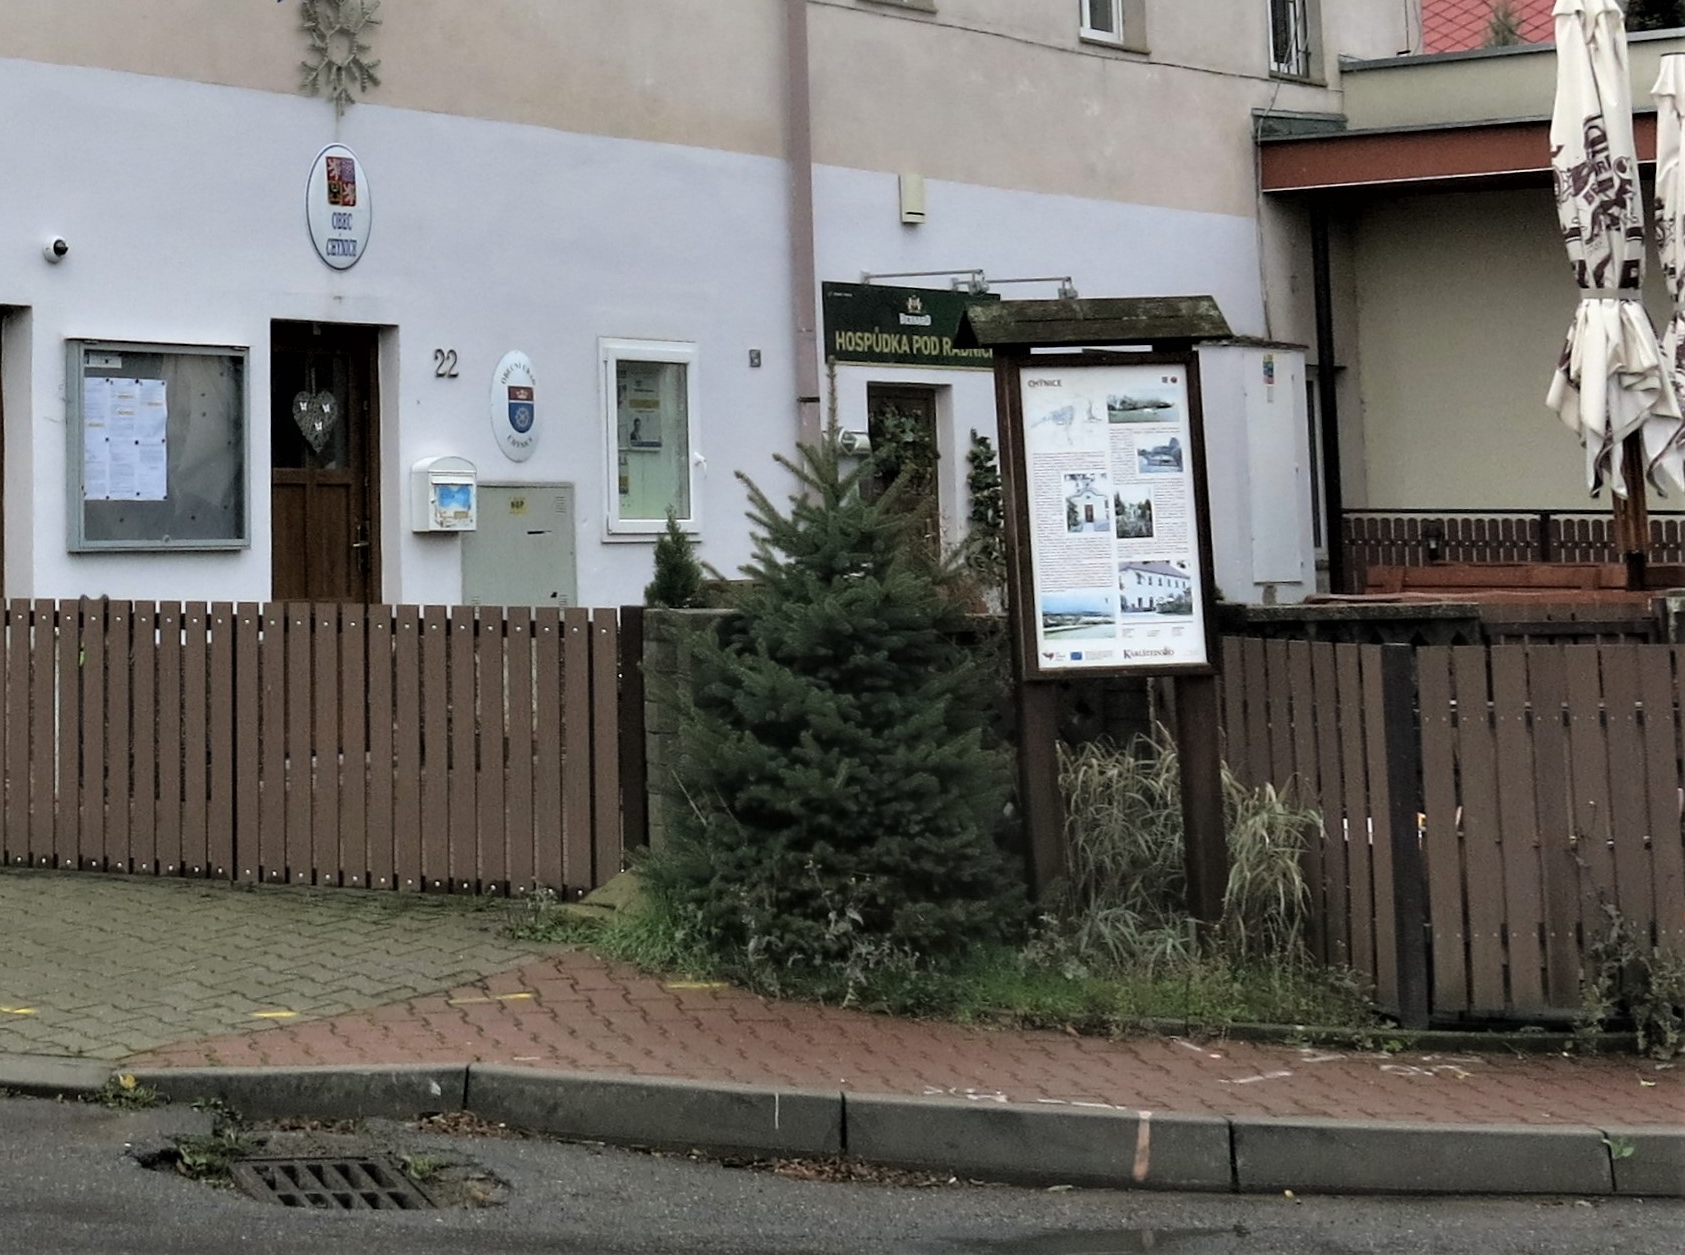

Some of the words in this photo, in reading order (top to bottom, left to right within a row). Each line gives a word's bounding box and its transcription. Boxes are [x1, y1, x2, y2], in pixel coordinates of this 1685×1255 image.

[331, 211, 353, 231] OBEC
[835, 326, 910, 354] HOSPŮDKA
[913, 334, 940, 356] POD
[434, 348, 460, 379] 22
